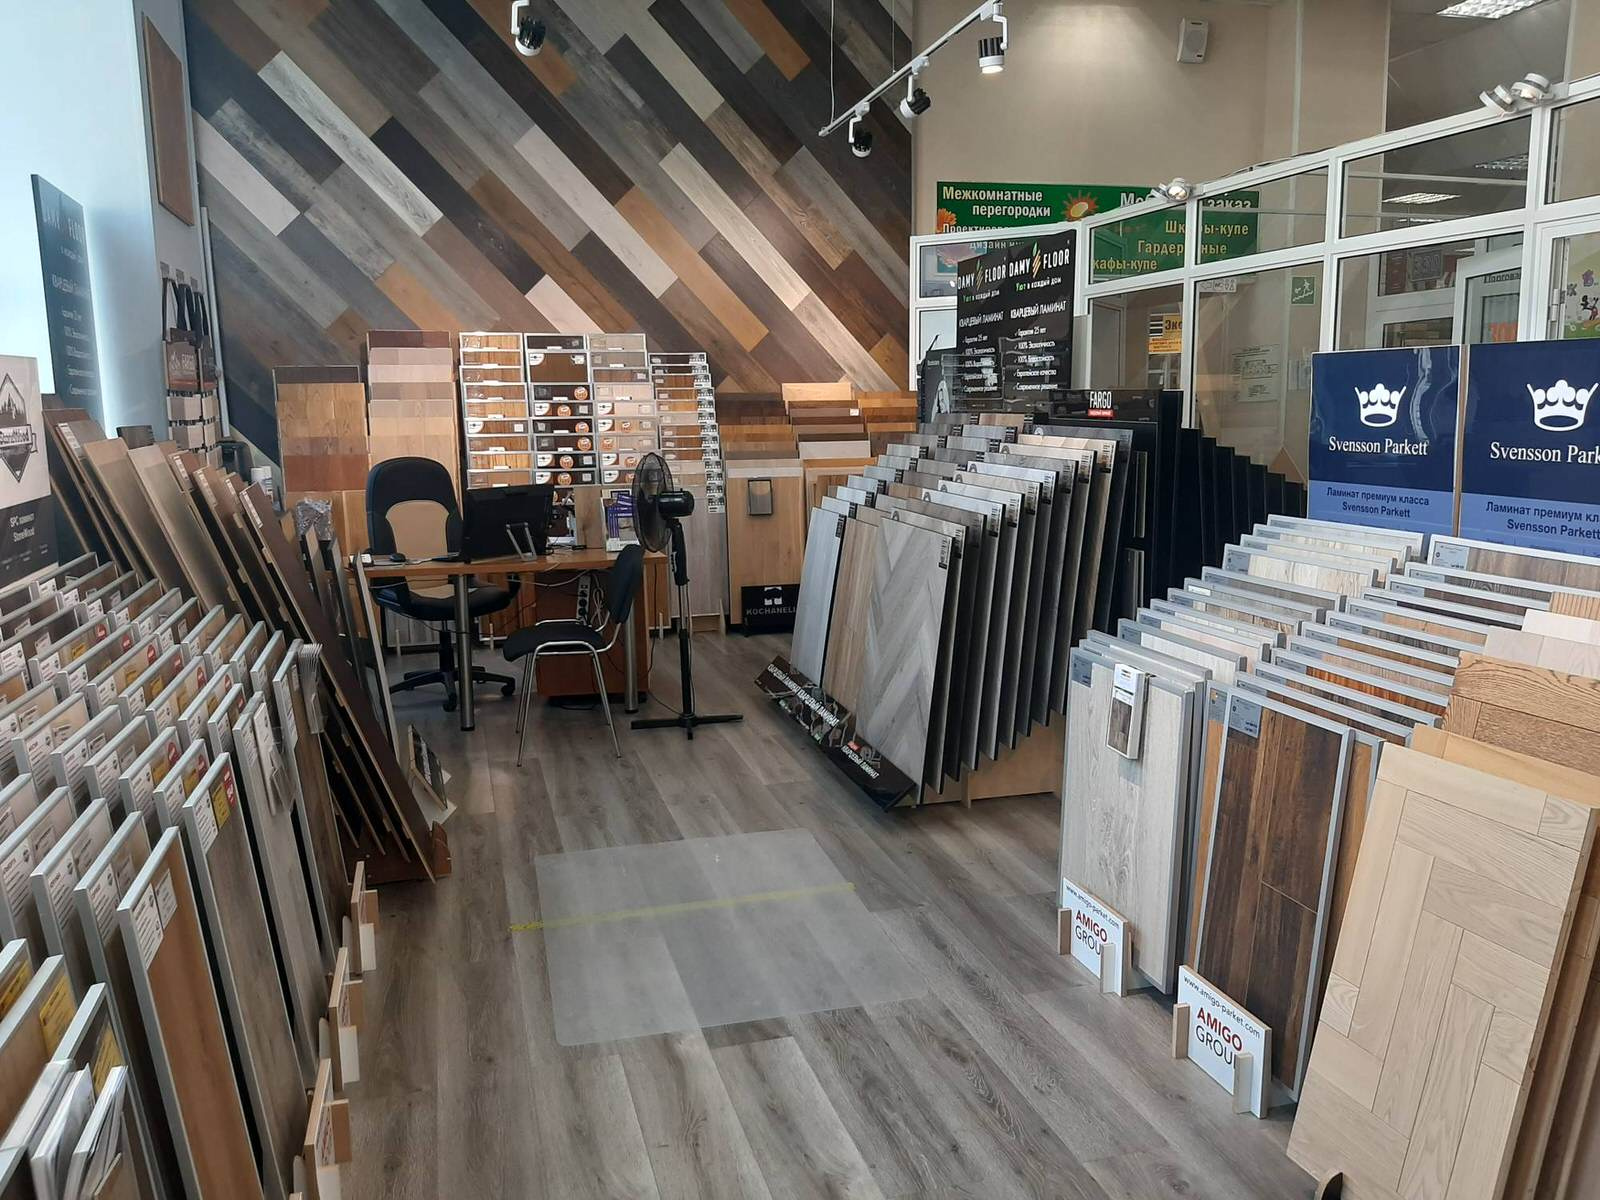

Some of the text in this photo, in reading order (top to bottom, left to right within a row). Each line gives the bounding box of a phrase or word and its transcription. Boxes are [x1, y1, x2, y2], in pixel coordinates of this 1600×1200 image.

[943, 186, 1043, 202] Межкомнатные
[972, 205, 1051, 219] перегородки
[1043, 248, 1070, 269] FLOOR
[984, 264, 1007, 283] FLOOR
[1090, 391, 1112, 408] FARGO
[1328, 436, 1427, 455] Svensson Parkett
[1490, 441, 1561, 462] Svensson
[1327, 487, 1429, 505] Ламинат премиум класса
[1342, 501, 1411, 518] Svensson Parkett
[1486, 501, 1531, 515] Ламинат
[1533, 507, 1582, 521] премиум
[1507, 518, 1557, 534] Svensson
[1075, 910, 1108, 942] AMIGO
[1075, 925, 1102, 955] GROU
[1183, 975, 1260, 1039] www.amigo-parket.com
[1197, 1007, 1242, 1051] AMIGO
[1196, 1025, 1236, 1070] GROU
